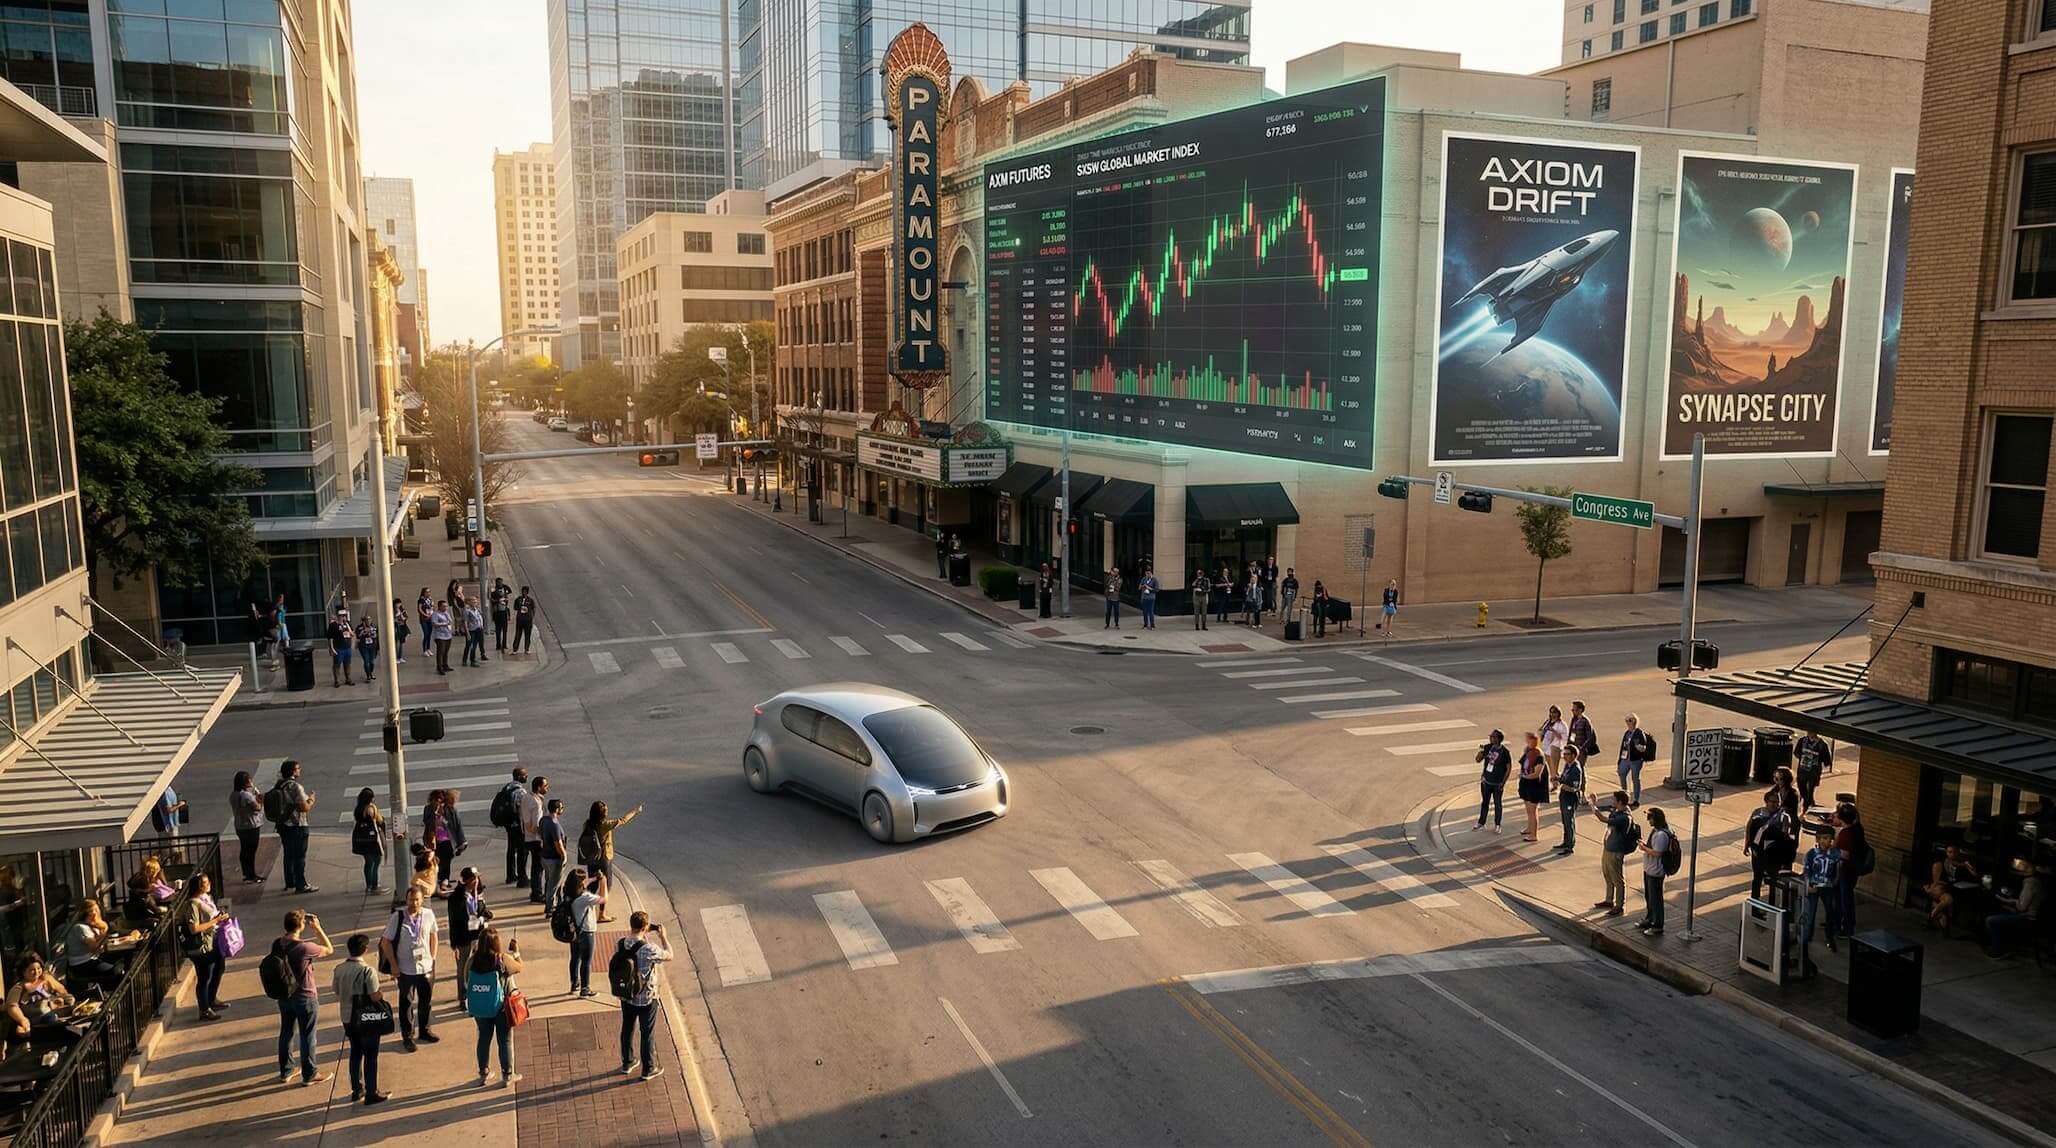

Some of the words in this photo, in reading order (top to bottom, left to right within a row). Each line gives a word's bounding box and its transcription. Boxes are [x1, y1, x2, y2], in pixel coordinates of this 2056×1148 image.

[1076, 161, 1100, 177] SXSW
[1100, 156, 1133, 172] GLOBAL
[1133, 149, 1171, 166] MARKET
[1171, 142, 1200, 160] INDEX
[1479, 157, 1603, 189] AXIOM
[988, 173, 1009, 189] AXM
[1009, 163, 1051, 186] FUTURES
[1488, 186, 1596, 216] DRIFT
[908, 87, 932, 363] PARAMOUNT
[1679, 393, 1776, 423] SYNAPSE
[1780, 393, 1827, 422] CITY
[1575, 497, 1628, 519] Congress
[1633, 507, 1649, 521] Ave
